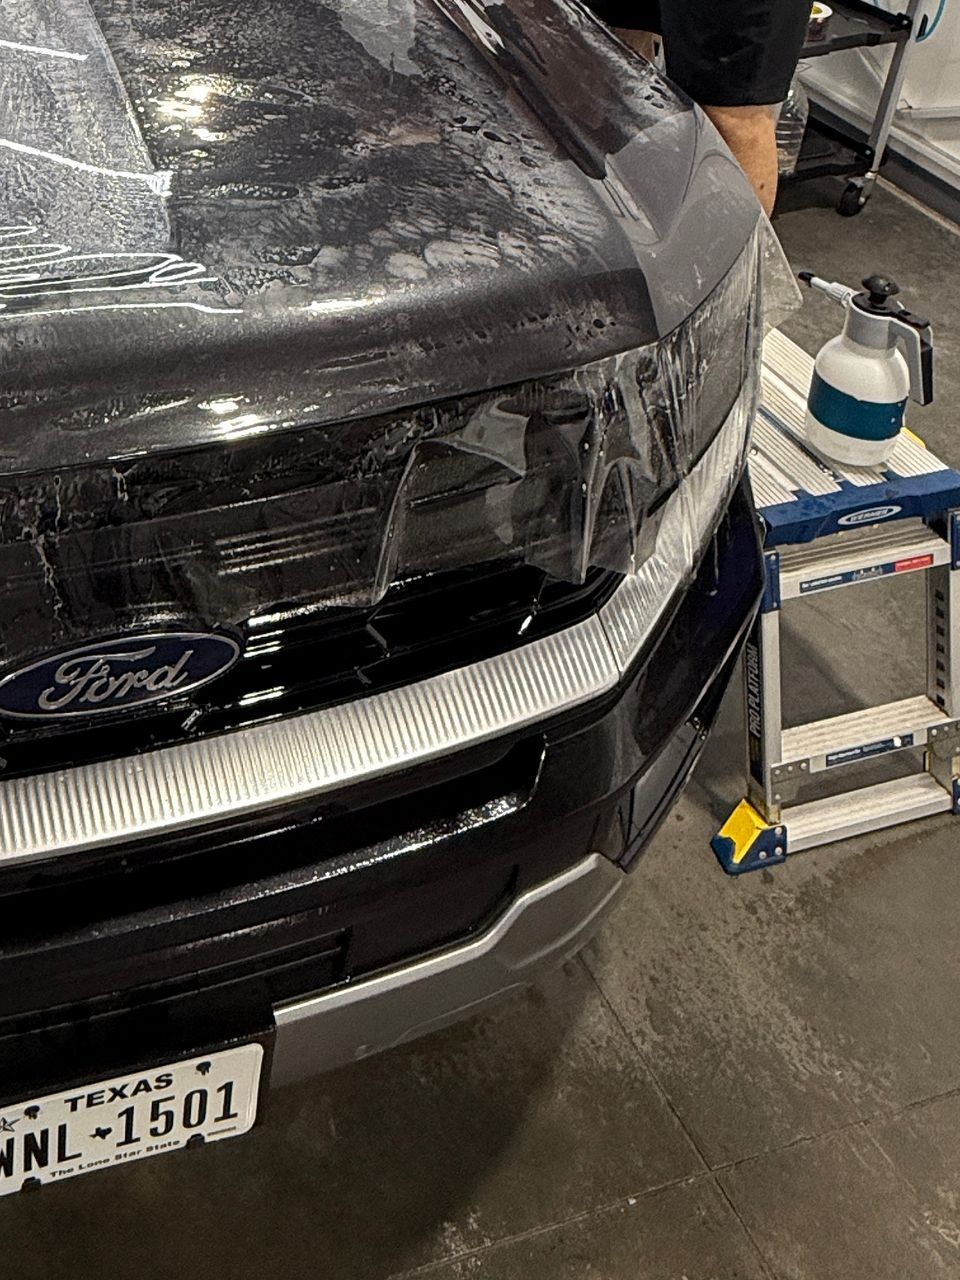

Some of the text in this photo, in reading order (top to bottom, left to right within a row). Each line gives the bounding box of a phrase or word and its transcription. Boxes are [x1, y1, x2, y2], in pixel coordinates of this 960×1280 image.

[39, 646, 194, 710] Ford
[746, 642, 761, 738] PRO PLATFORM
[64, 1073, 173, 1113] TEXAS
[115, 1081, 239, 1148] 1501
[50, 1139, 181, 1178] The Lone Star State
